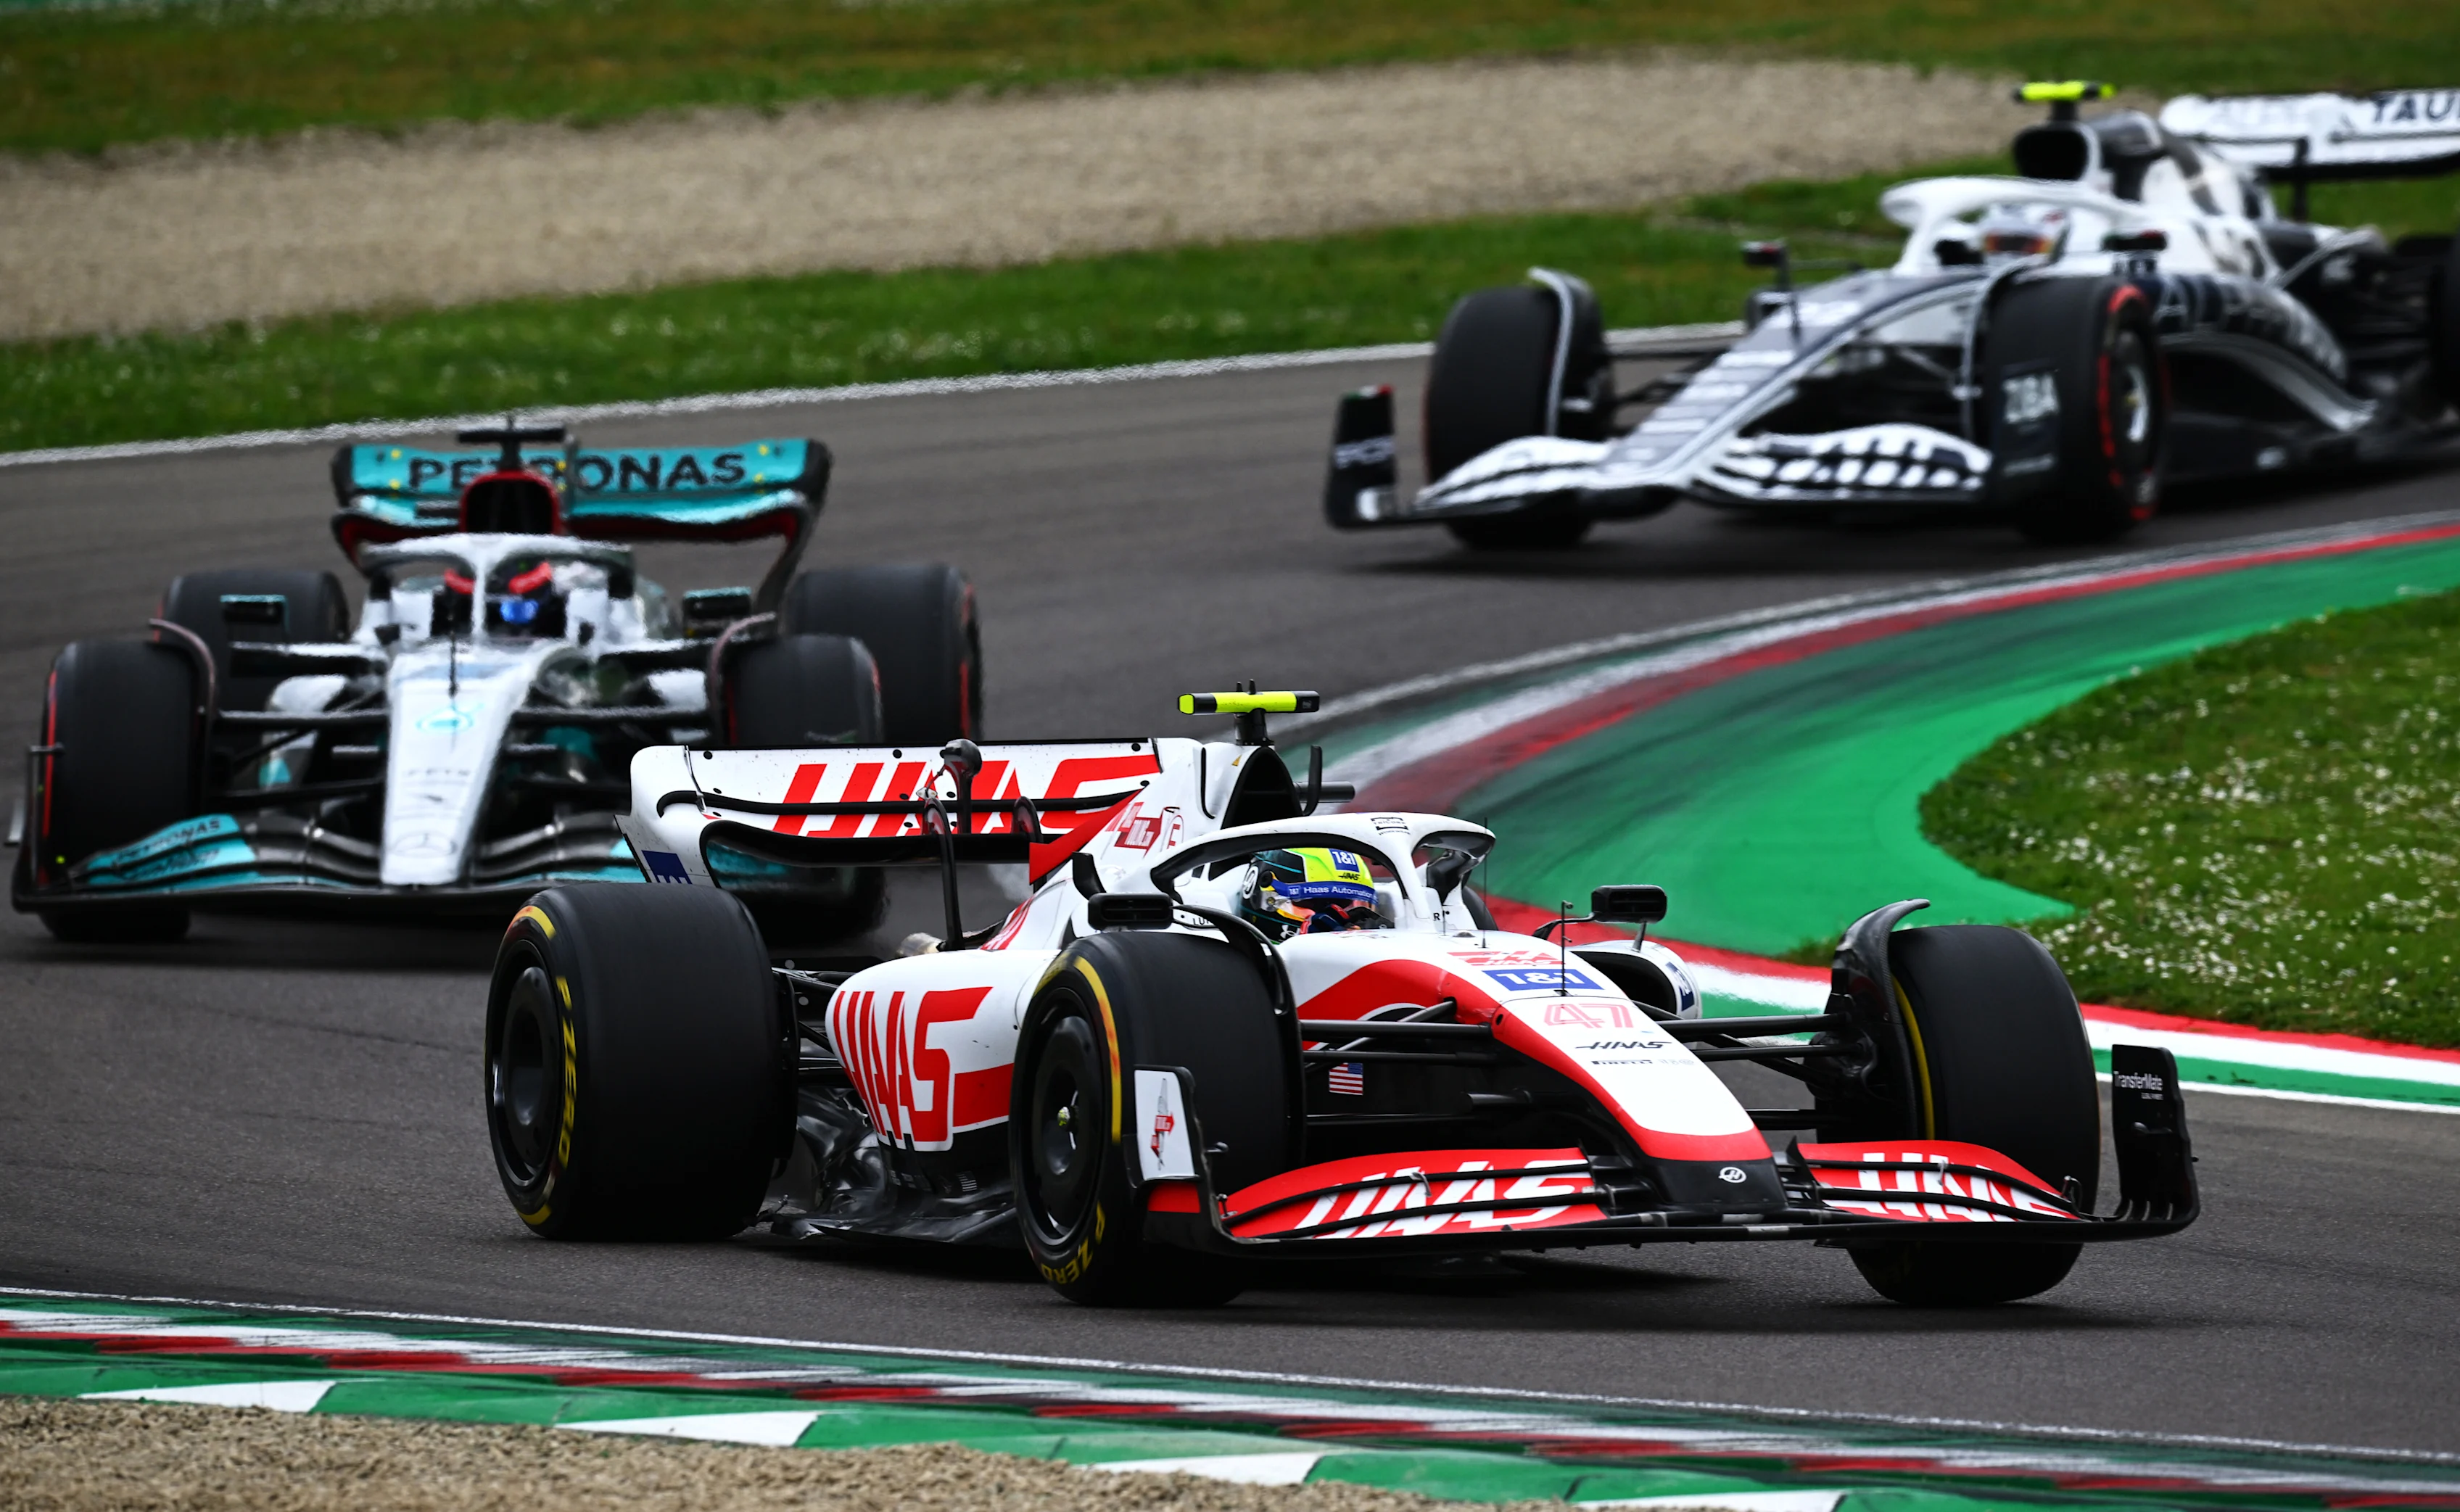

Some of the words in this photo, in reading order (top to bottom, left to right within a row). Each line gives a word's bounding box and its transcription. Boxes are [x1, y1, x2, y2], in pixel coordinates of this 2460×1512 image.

[2369, 91, 2460, 122] TAU
[772, 755, 1160, 836] HAAS
[1332, 851, 1357, 865] 1&1
[1332, 886, 1372, 898] Automation
[1433, 912, 1440, 921] R
[1496, 972, 1585, 985] 1&1
[1544, 1004, 1634, 1028] 47
[833, 986, 993, 1142] HAAS
[2113, 1070, 2163, 1091] TransferMate
[558, 1017, 577, 1169] ZERO
[1041, 1236, 1093, 1284] ZERO
